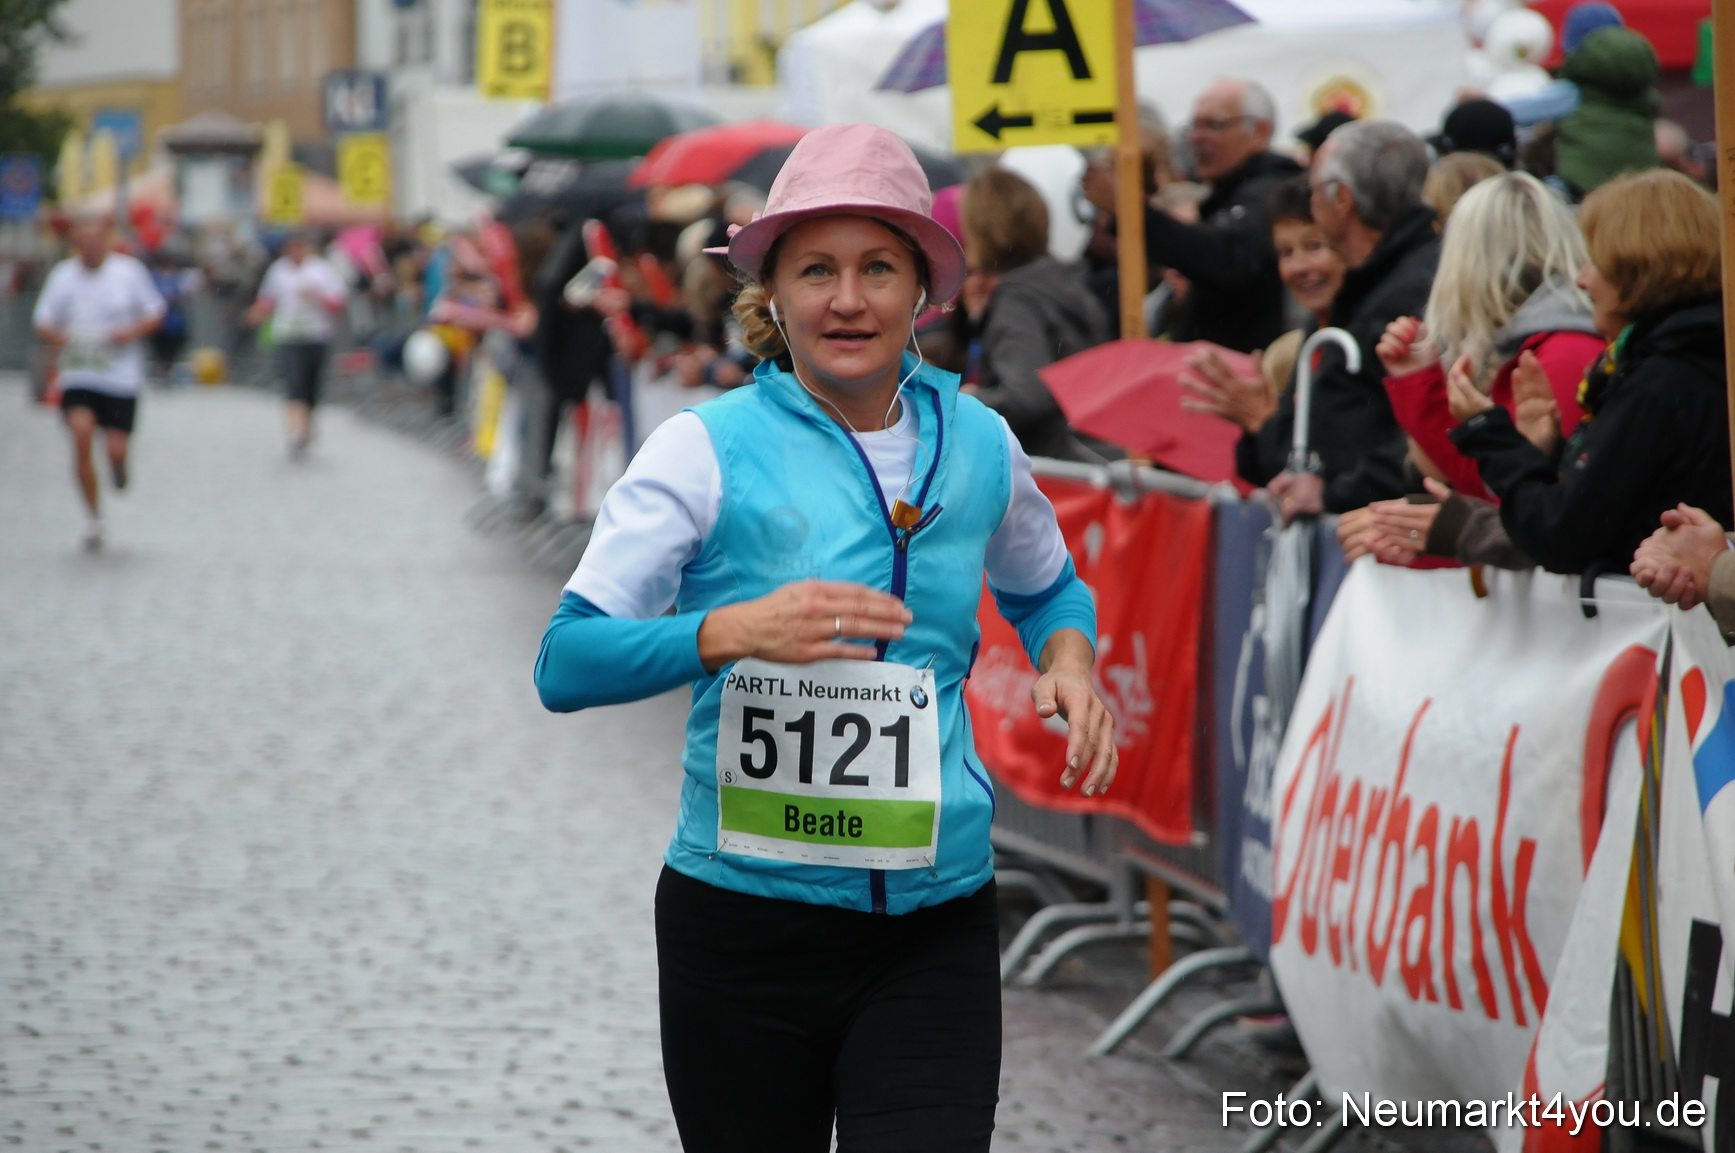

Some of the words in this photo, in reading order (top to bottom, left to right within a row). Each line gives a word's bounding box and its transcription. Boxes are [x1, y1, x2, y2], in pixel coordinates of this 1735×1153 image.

[501, 20, 536, 76] B
[991, 0, 1092, 83] A
[726, 672, 792, 697] PARTL
[798, 679, 902, 702] Neumarkt
[739, 705, 910, 788] 5121
[723, 770, 733, 783] S
[784, 804, 863, 838] Beate
[1271, 675, 1549, 1028] Oberbank
